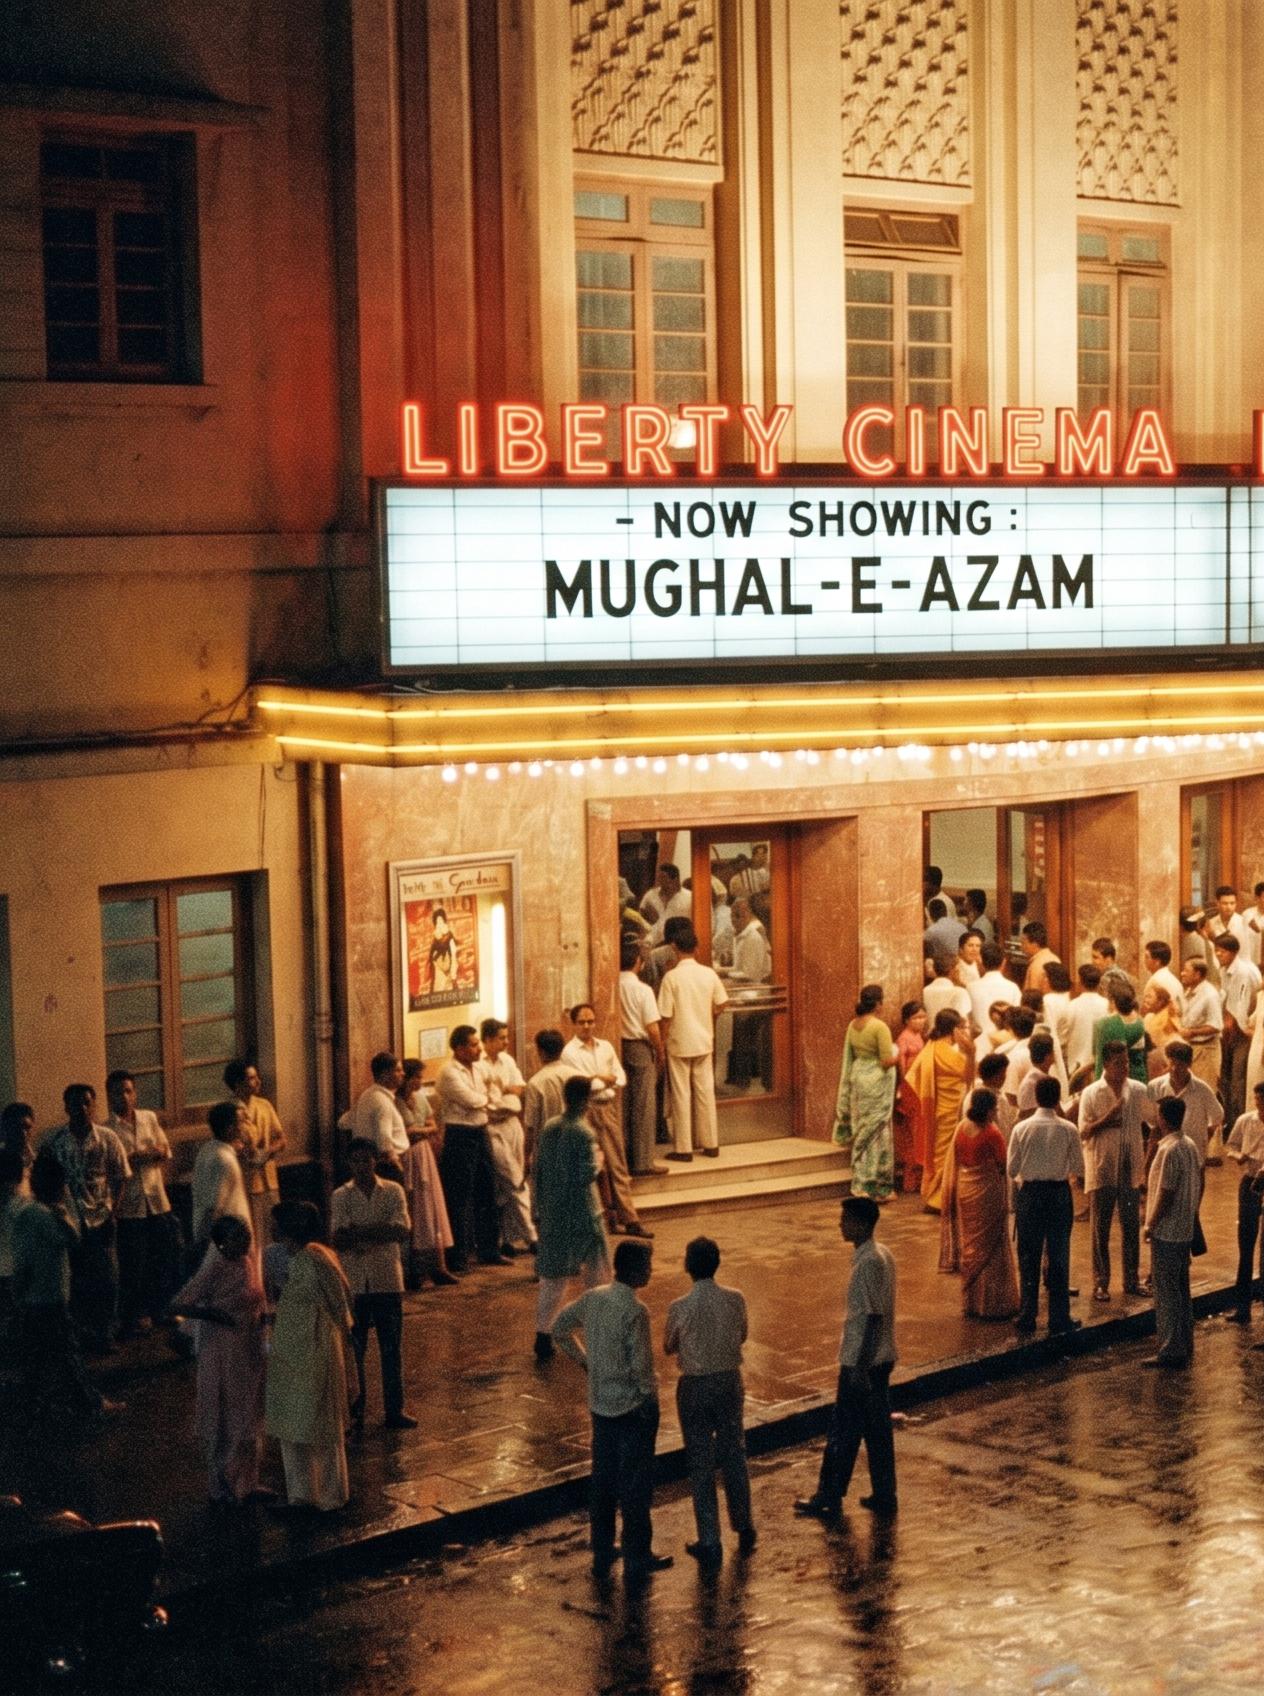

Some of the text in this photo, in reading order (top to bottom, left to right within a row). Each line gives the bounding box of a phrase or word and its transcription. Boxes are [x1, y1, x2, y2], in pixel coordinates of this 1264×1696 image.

[402, 402, 1177, 478] LIBERTY CINEMA
[544, 553, 1095, 619] MUGHAL-E-AZAM
